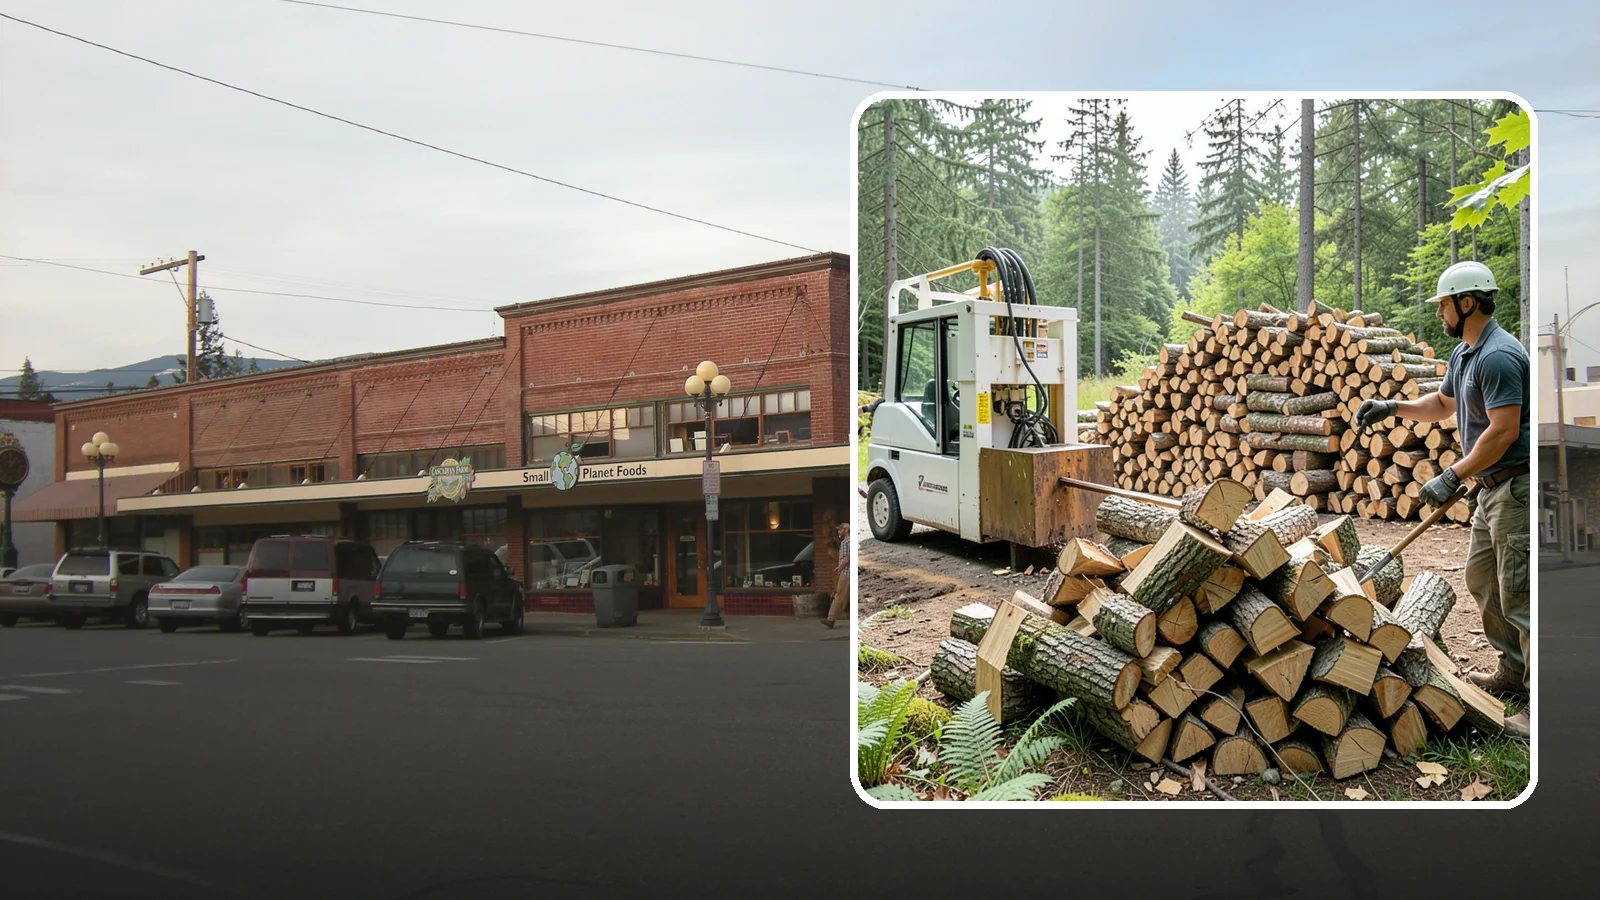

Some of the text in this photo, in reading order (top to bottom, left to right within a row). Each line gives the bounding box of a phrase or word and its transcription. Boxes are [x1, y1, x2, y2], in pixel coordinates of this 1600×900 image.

[523, 464, 647, 483] Small Planet Foods
